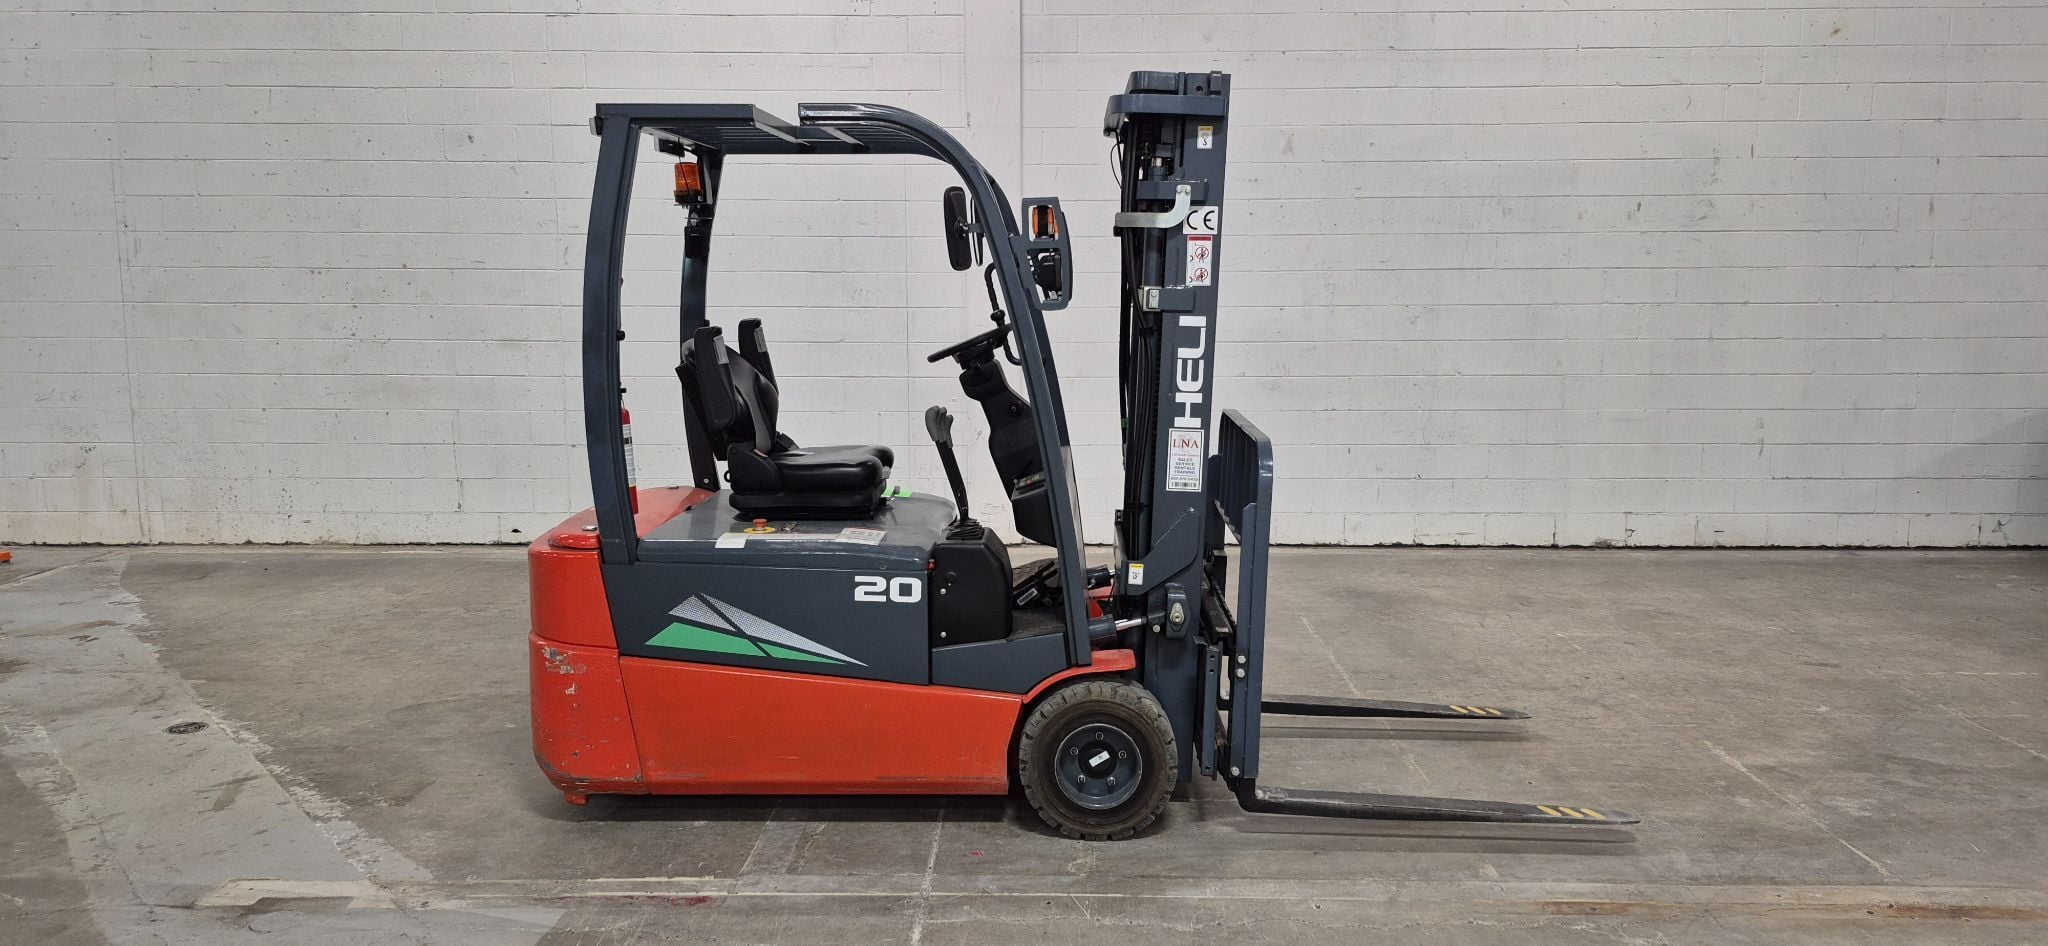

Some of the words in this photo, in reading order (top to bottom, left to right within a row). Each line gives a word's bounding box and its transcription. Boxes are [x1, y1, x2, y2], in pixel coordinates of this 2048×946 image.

[1187, 210, 1215, 230] CE
[1174, 316, 1206, 428] HELI
[1173, 439, 1199, 449] LNA
[854, 576, 922, 603] 20
